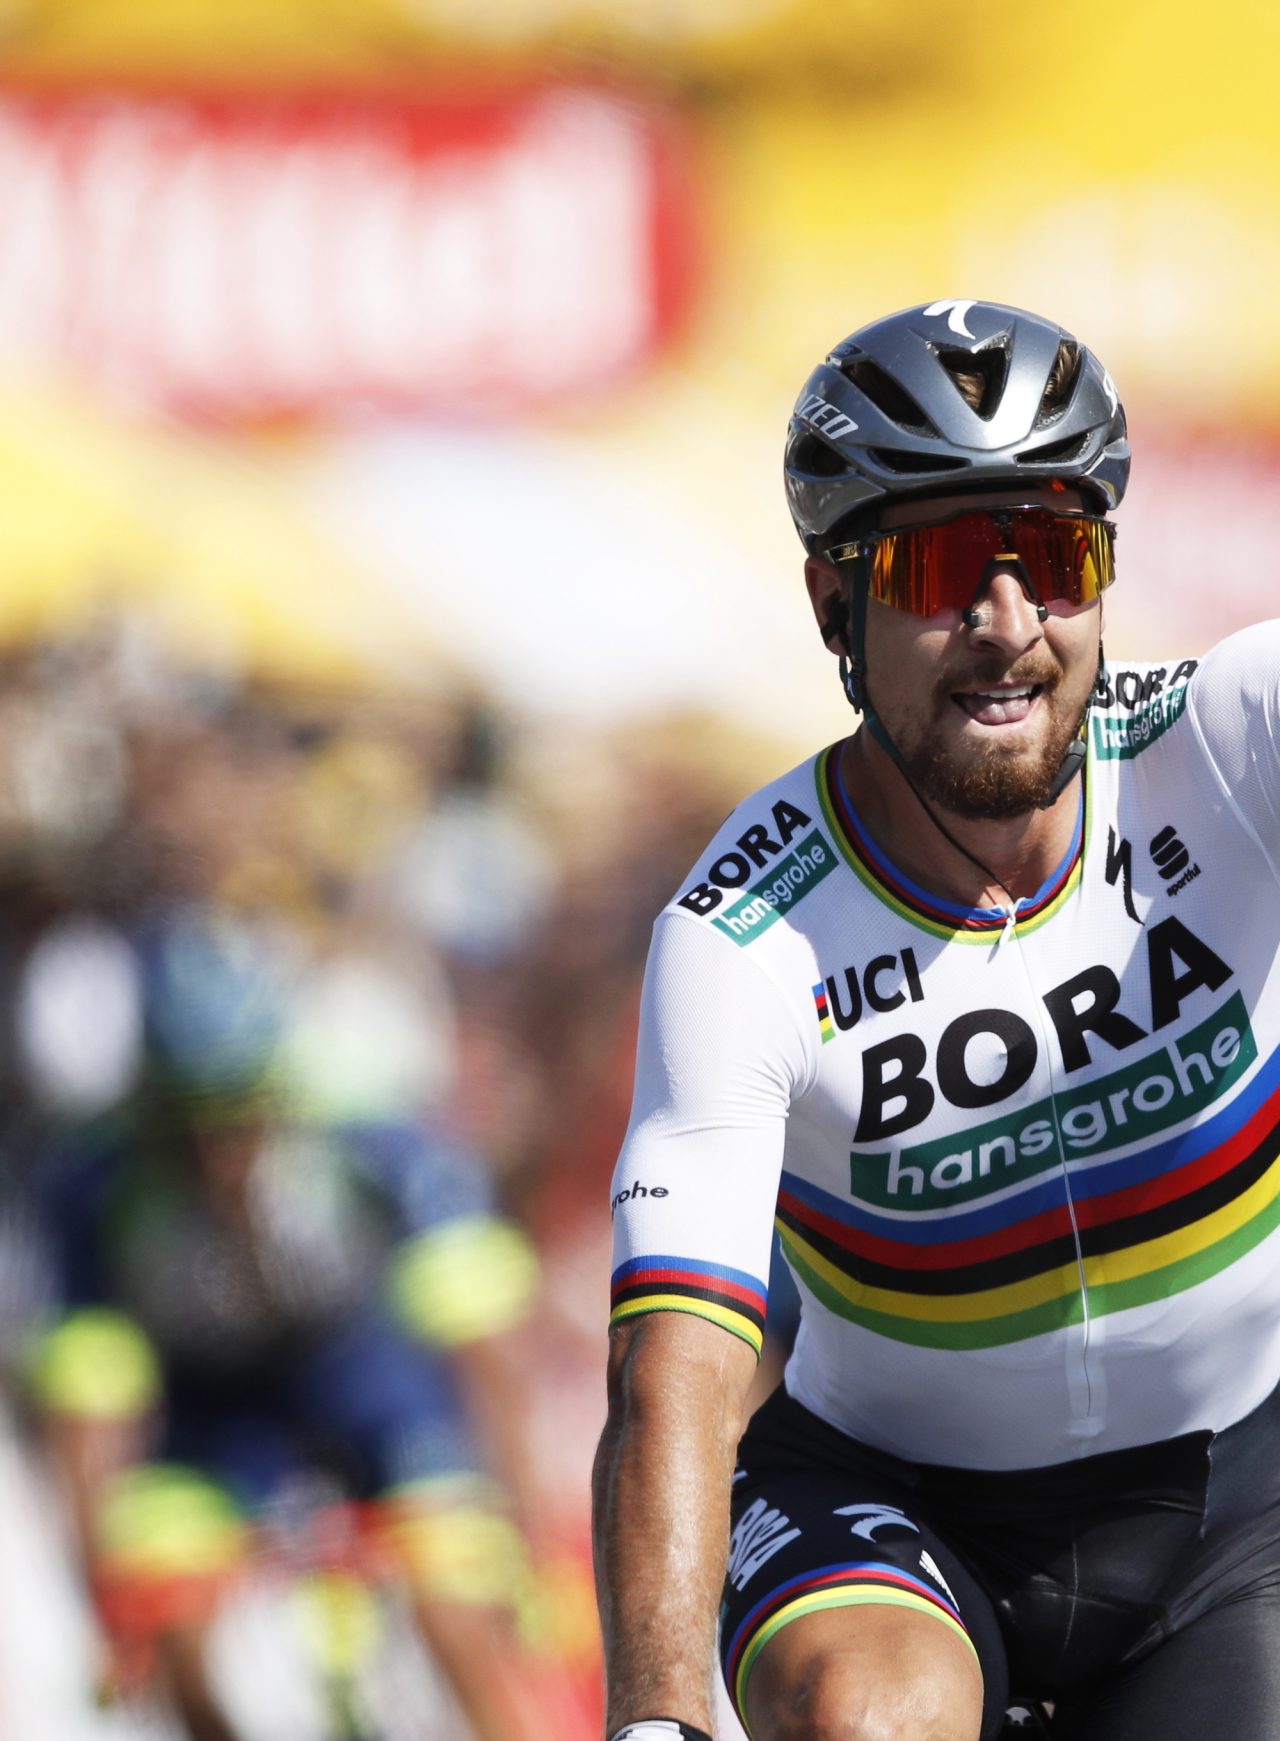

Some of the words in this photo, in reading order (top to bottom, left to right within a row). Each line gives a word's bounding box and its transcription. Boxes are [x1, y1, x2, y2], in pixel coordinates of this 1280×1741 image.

[677, 800, 812, 916] BORA
[716, 845, 826, 935] hansgrohe
[825, 947, 925, 1031] UCI
[853, 915, 1234, 1143] BORA
[887, 1026, 1241, 1196] hansgrohe
